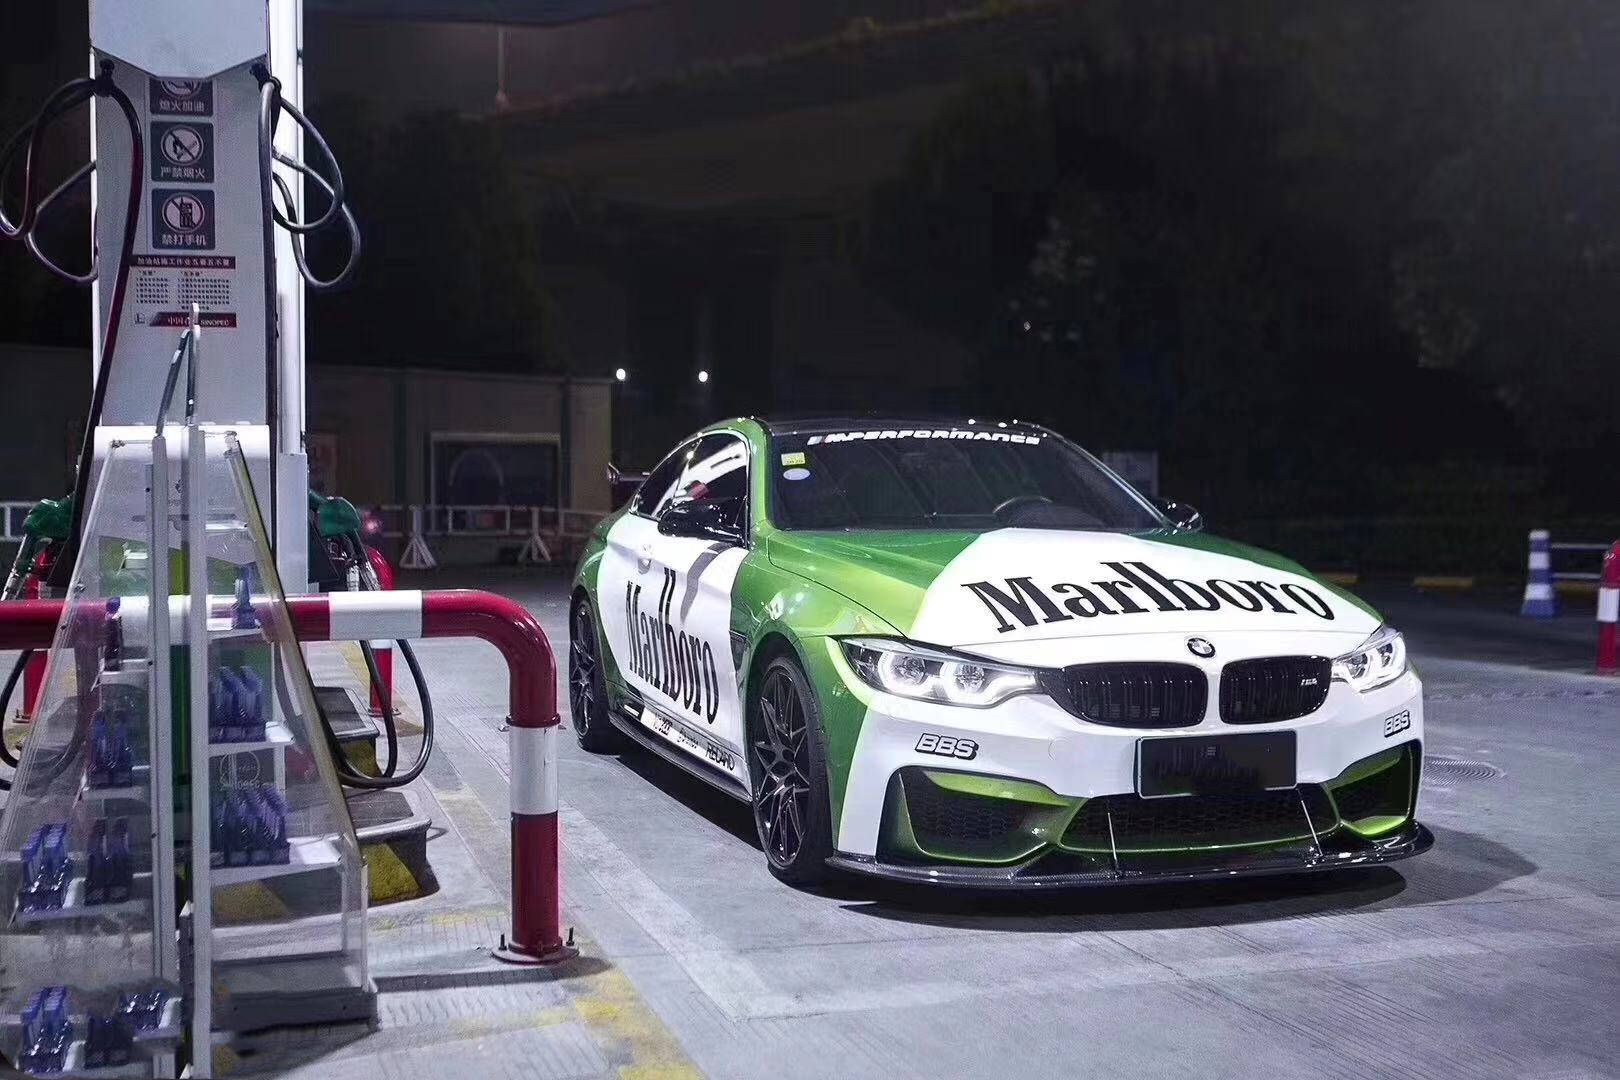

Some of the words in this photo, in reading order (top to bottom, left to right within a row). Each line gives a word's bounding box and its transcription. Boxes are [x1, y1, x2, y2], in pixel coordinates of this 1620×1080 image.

[160, 166, 206, 179] 严禁烟火
[161, 234, 207, 246] 禁打手机
[960, 561, 1335, 633] Marlboro
[625, 567, 720, 725] Marlboro
[1384, 709, 1411, 738] BBS
[915, 733, 979, 760] BBS
